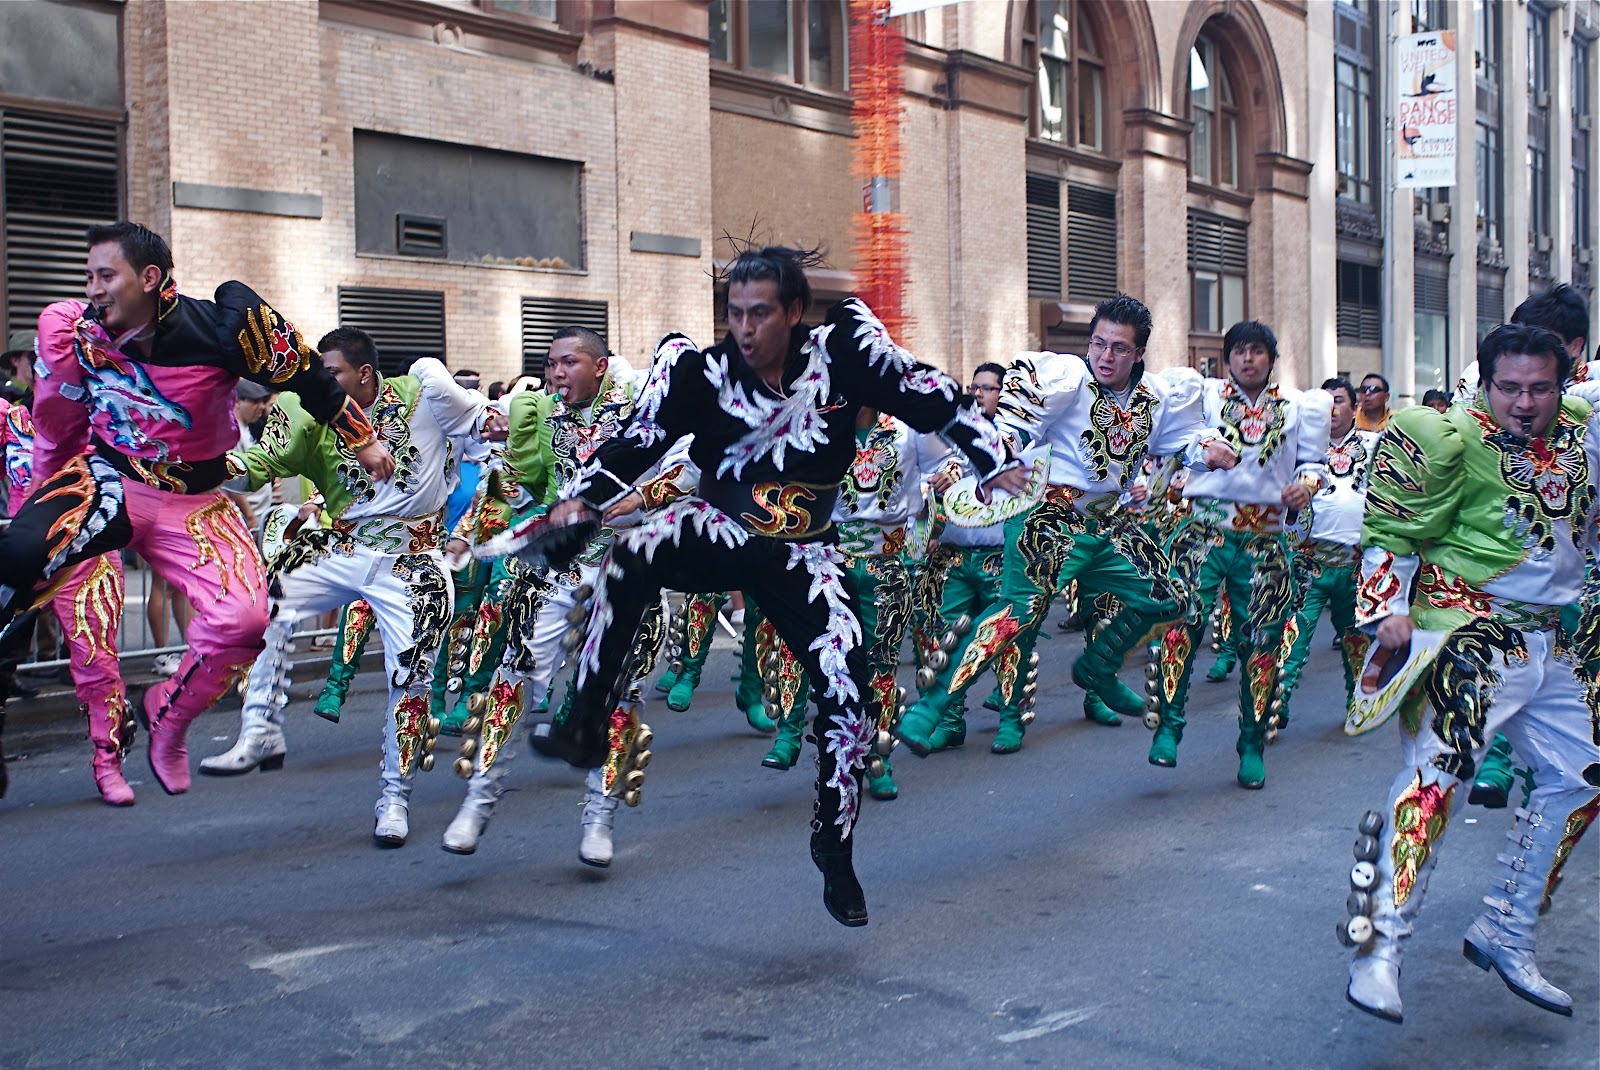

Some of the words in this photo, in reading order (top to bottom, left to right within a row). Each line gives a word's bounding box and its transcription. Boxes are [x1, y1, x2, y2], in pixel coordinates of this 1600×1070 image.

[1401, 47, 1448, 63] UNITED
[1400, 100, 1455, 117] DANCE
[1400, 110, 1455, 127] PARADE
